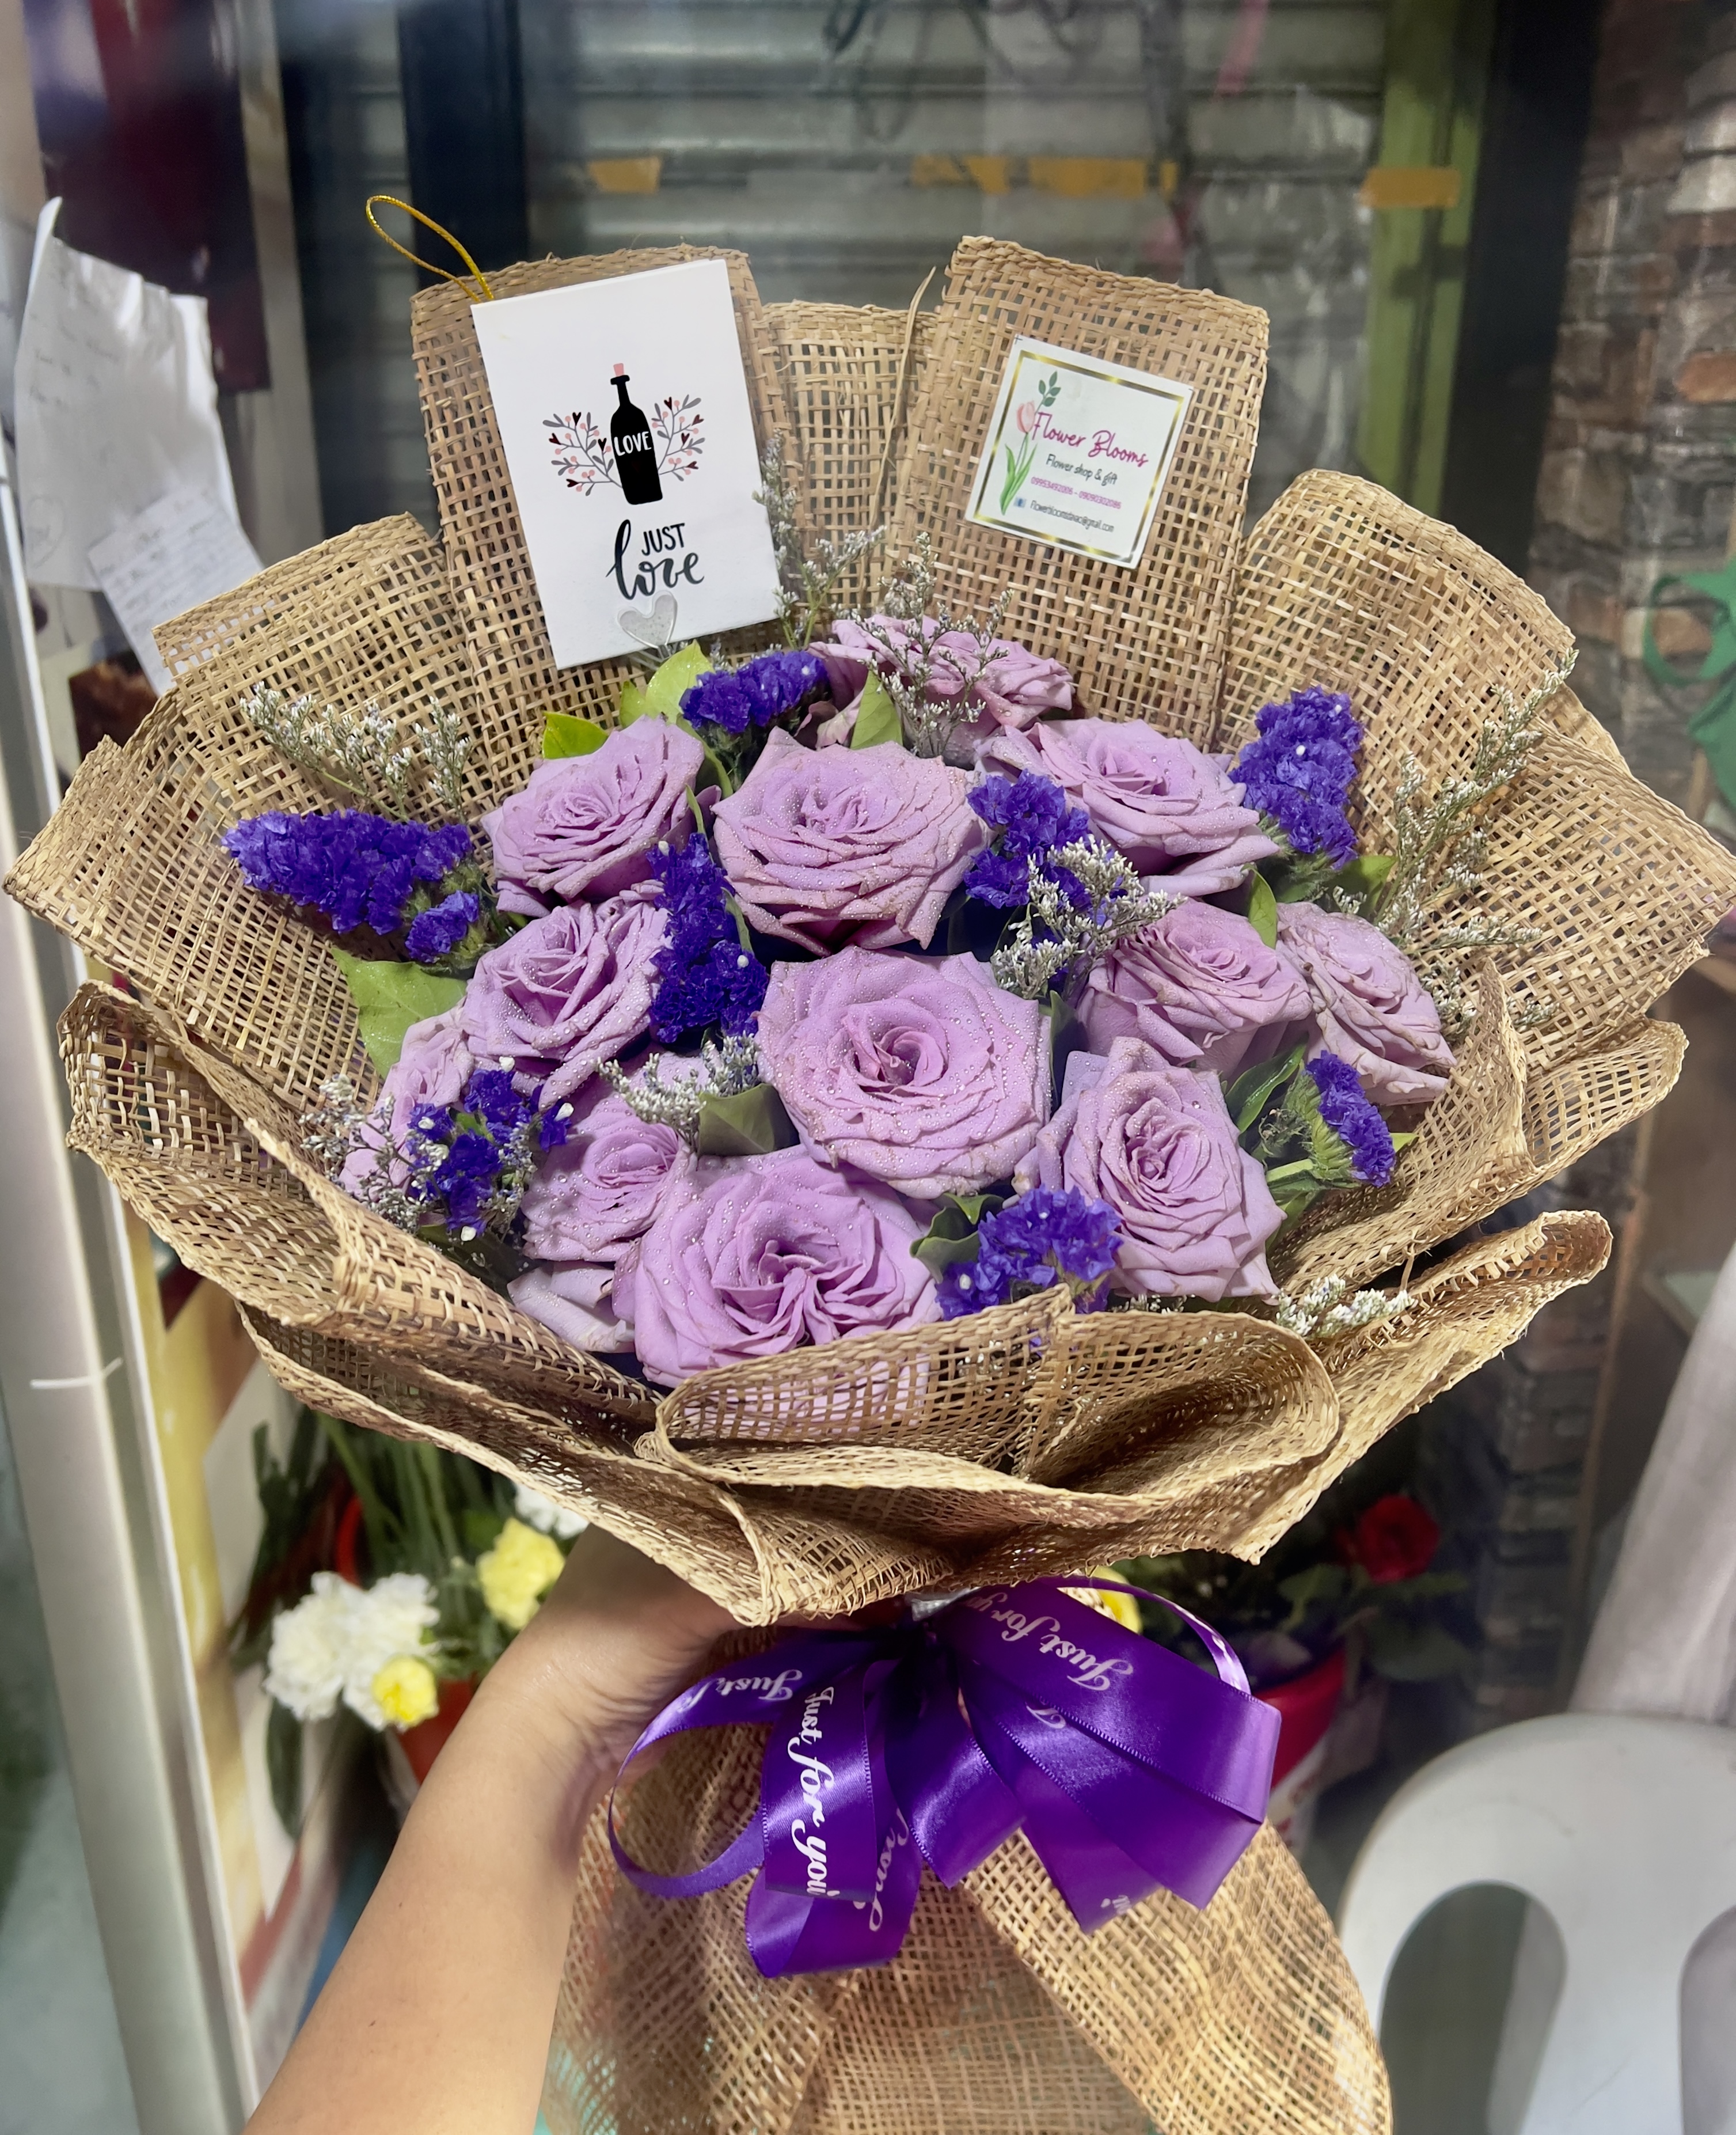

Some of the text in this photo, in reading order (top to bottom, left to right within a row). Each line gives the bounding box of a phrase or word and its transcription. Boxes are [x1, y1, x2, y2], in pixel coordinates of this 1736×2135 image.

[613, 431, 652, 457] LOVE
[1032, 412, 1149, 468] Flower Blooms
[1046, 454, 1118, 486] Flower shop & gift
[605, 519, 705, 600] love
[641, 523, 685, 556] JUST
[990, 1609, 1061, 1641] for
[1038, 1634, 1133, 1691] Just
[800, 1686, 834, 1746] Just
[787, 1736, 835, 1828] for
